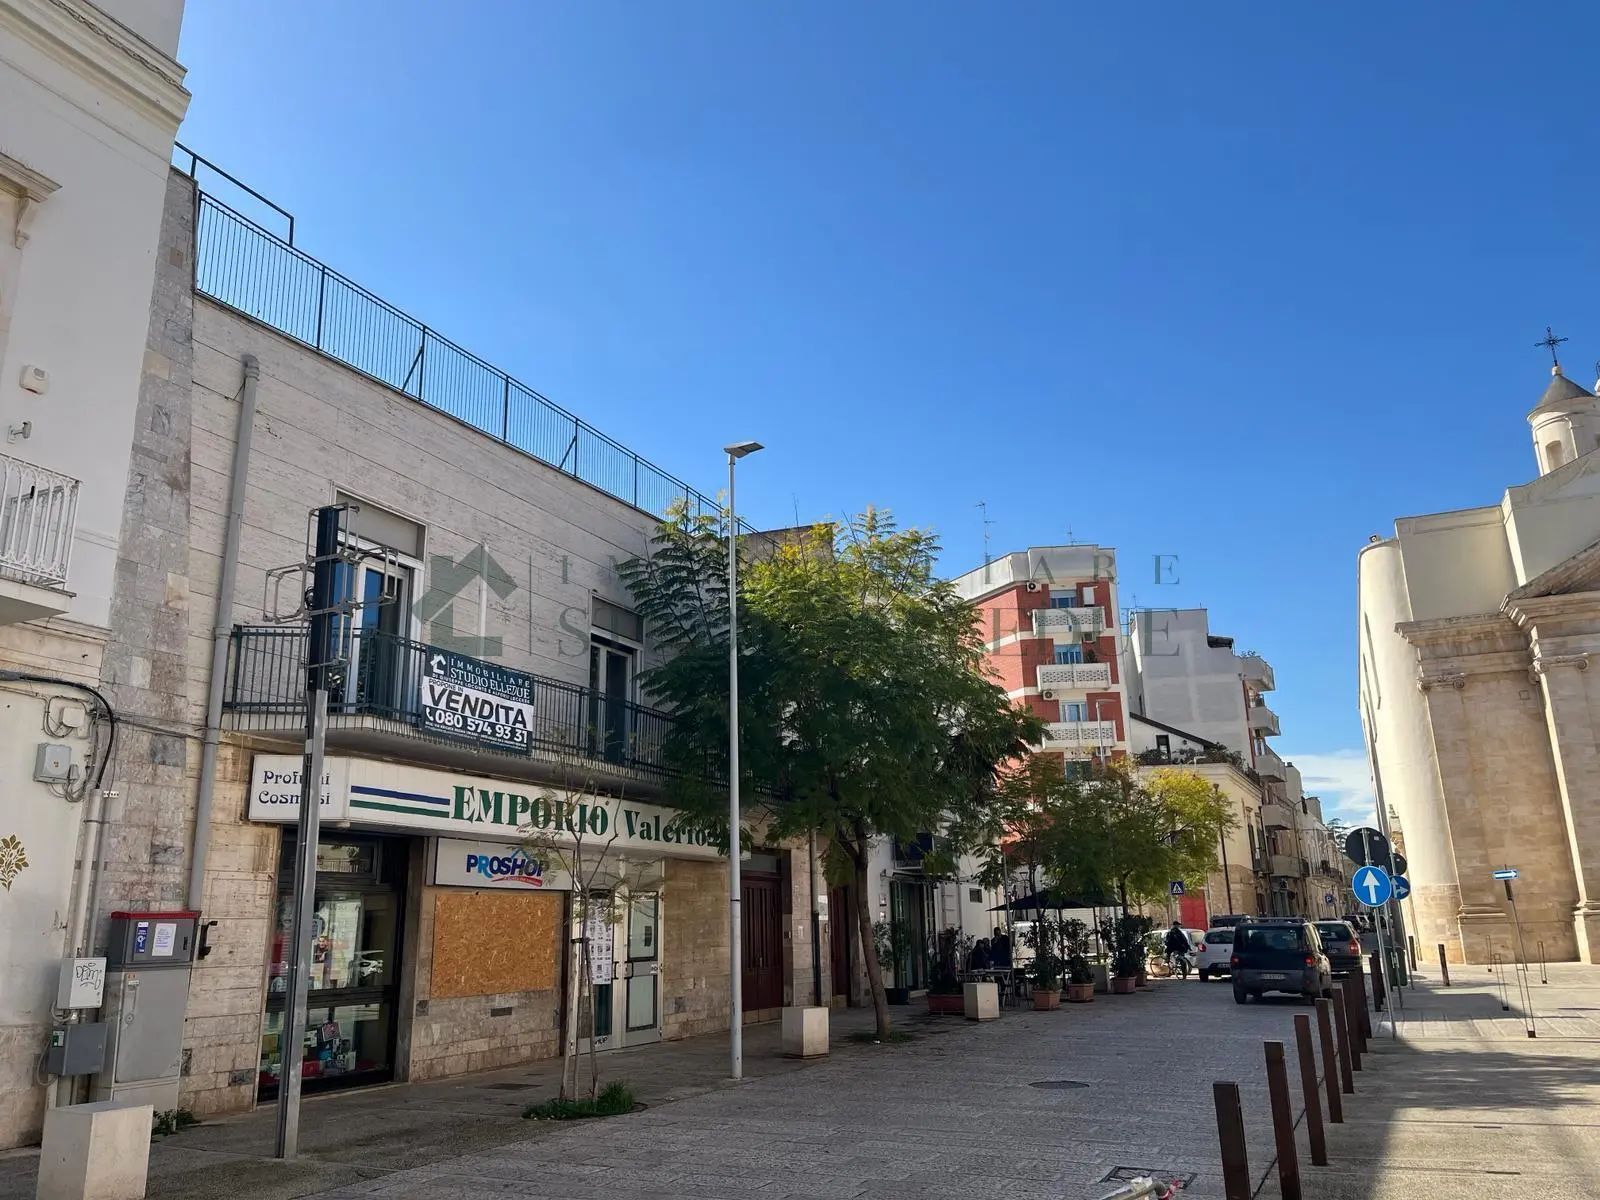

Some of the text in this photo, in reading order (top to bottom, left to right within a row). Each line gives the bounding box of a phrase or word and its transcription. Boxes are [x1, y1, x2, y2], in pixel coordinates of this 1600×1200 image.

[428, 678, 464, 693] PROPONE IN
[450, 667, 531, 699] STUDIO ELLEDUE
[451, 658, 531, 689] IMMOBILIARE
[428, 684, 528, 730] VENDITA
[435, 709, 463, 729] 080
[466, 717, 493, 736] 574
[495, 724, 511, 740] 93
[513, 729, 529, 744] 31
[262, 770, 331, 785] Profi
[451, 785, 609, 836] EMPORIO
